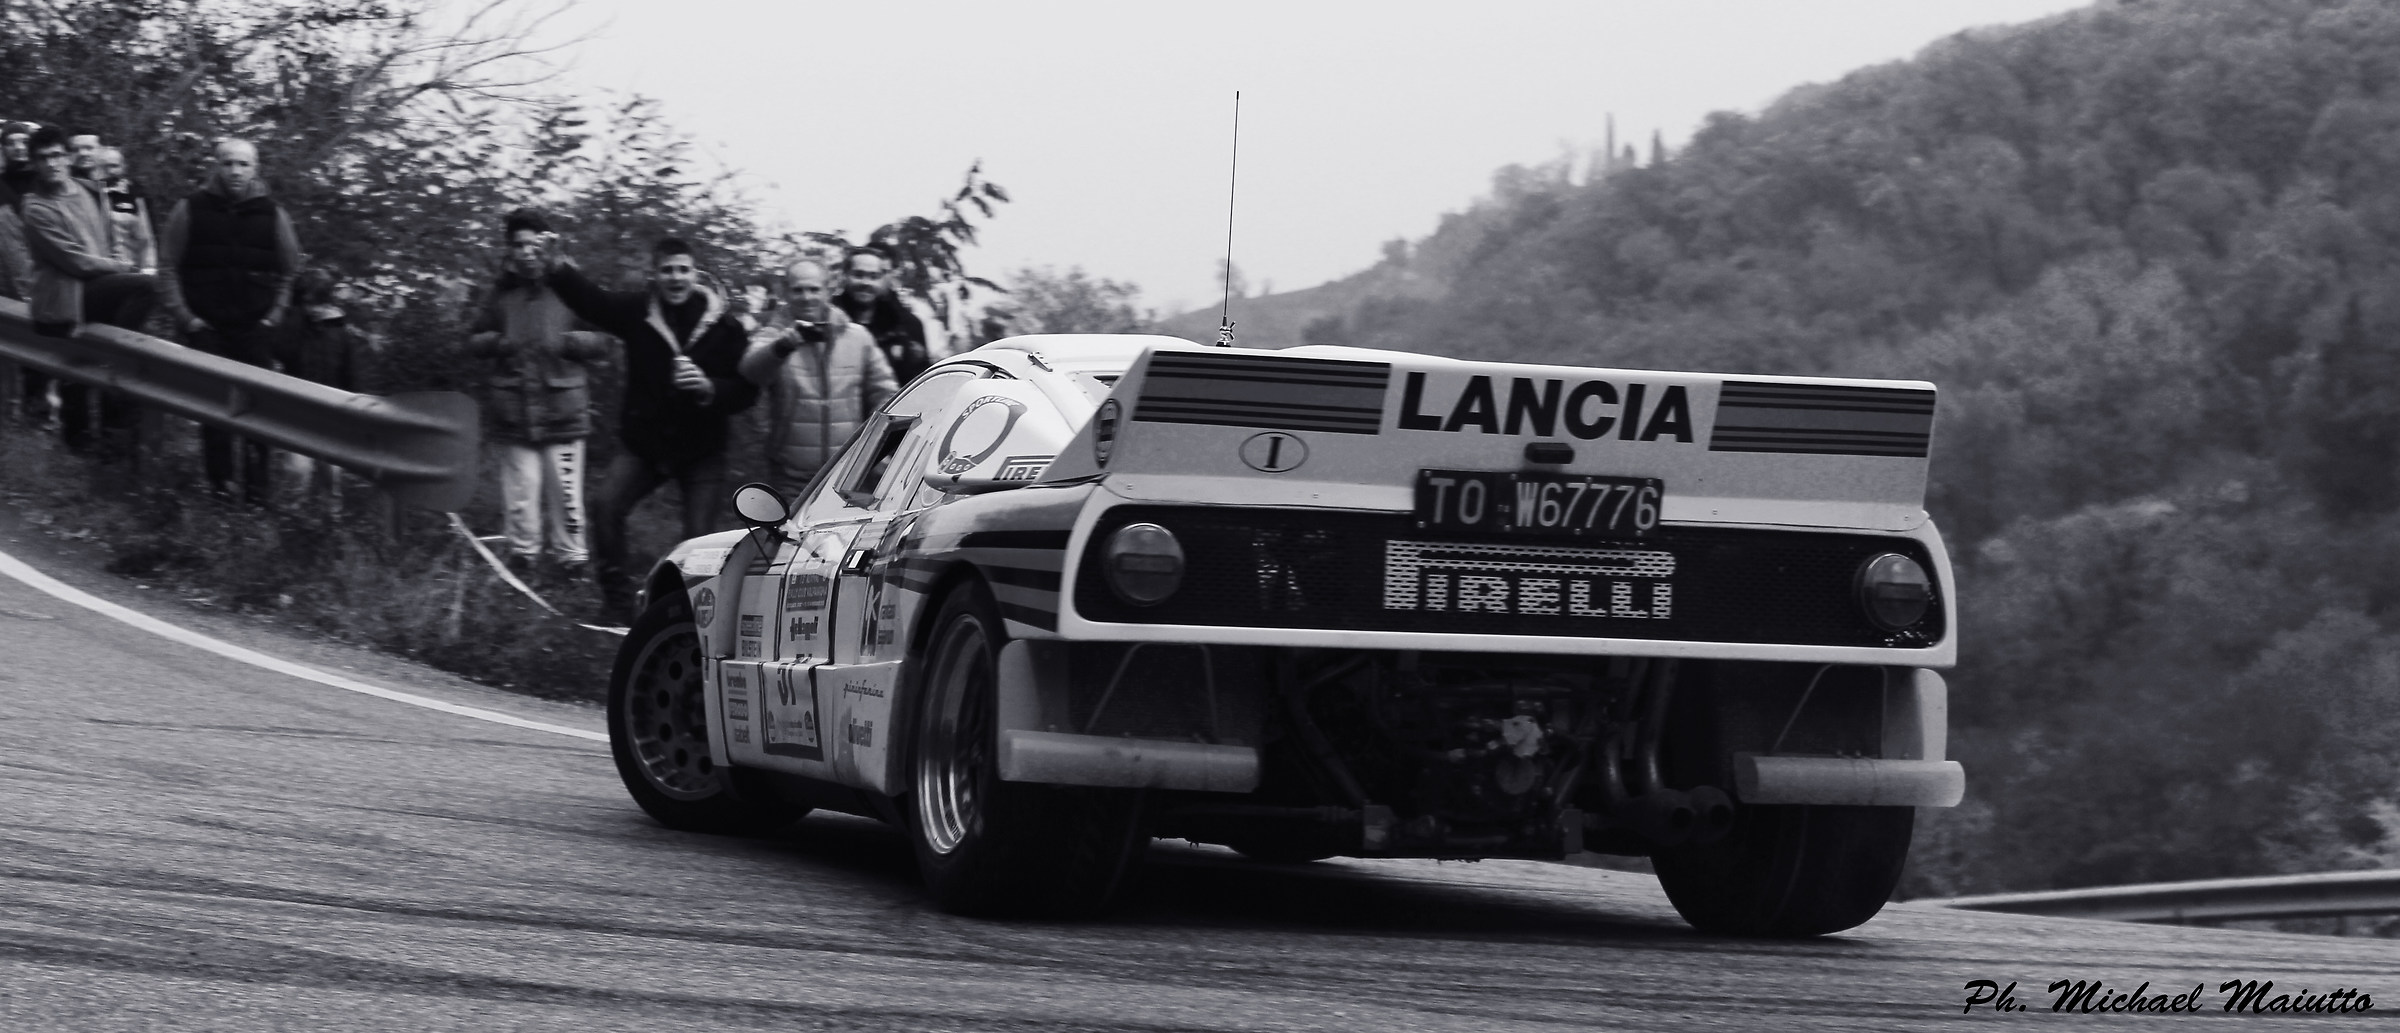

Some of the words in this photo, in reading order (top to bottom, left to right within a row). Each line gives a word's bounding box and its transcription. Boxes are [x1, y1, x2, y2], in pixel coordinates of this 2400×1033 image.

[1399, 372, 1694, 443] LANCIA
[1263, 437, 1285, 468] I
[1428, 477, 1488, 525] TO
[1515, 481, 1659, 530] W67776
[1384, 539, 1676, 620] PIRELLI
